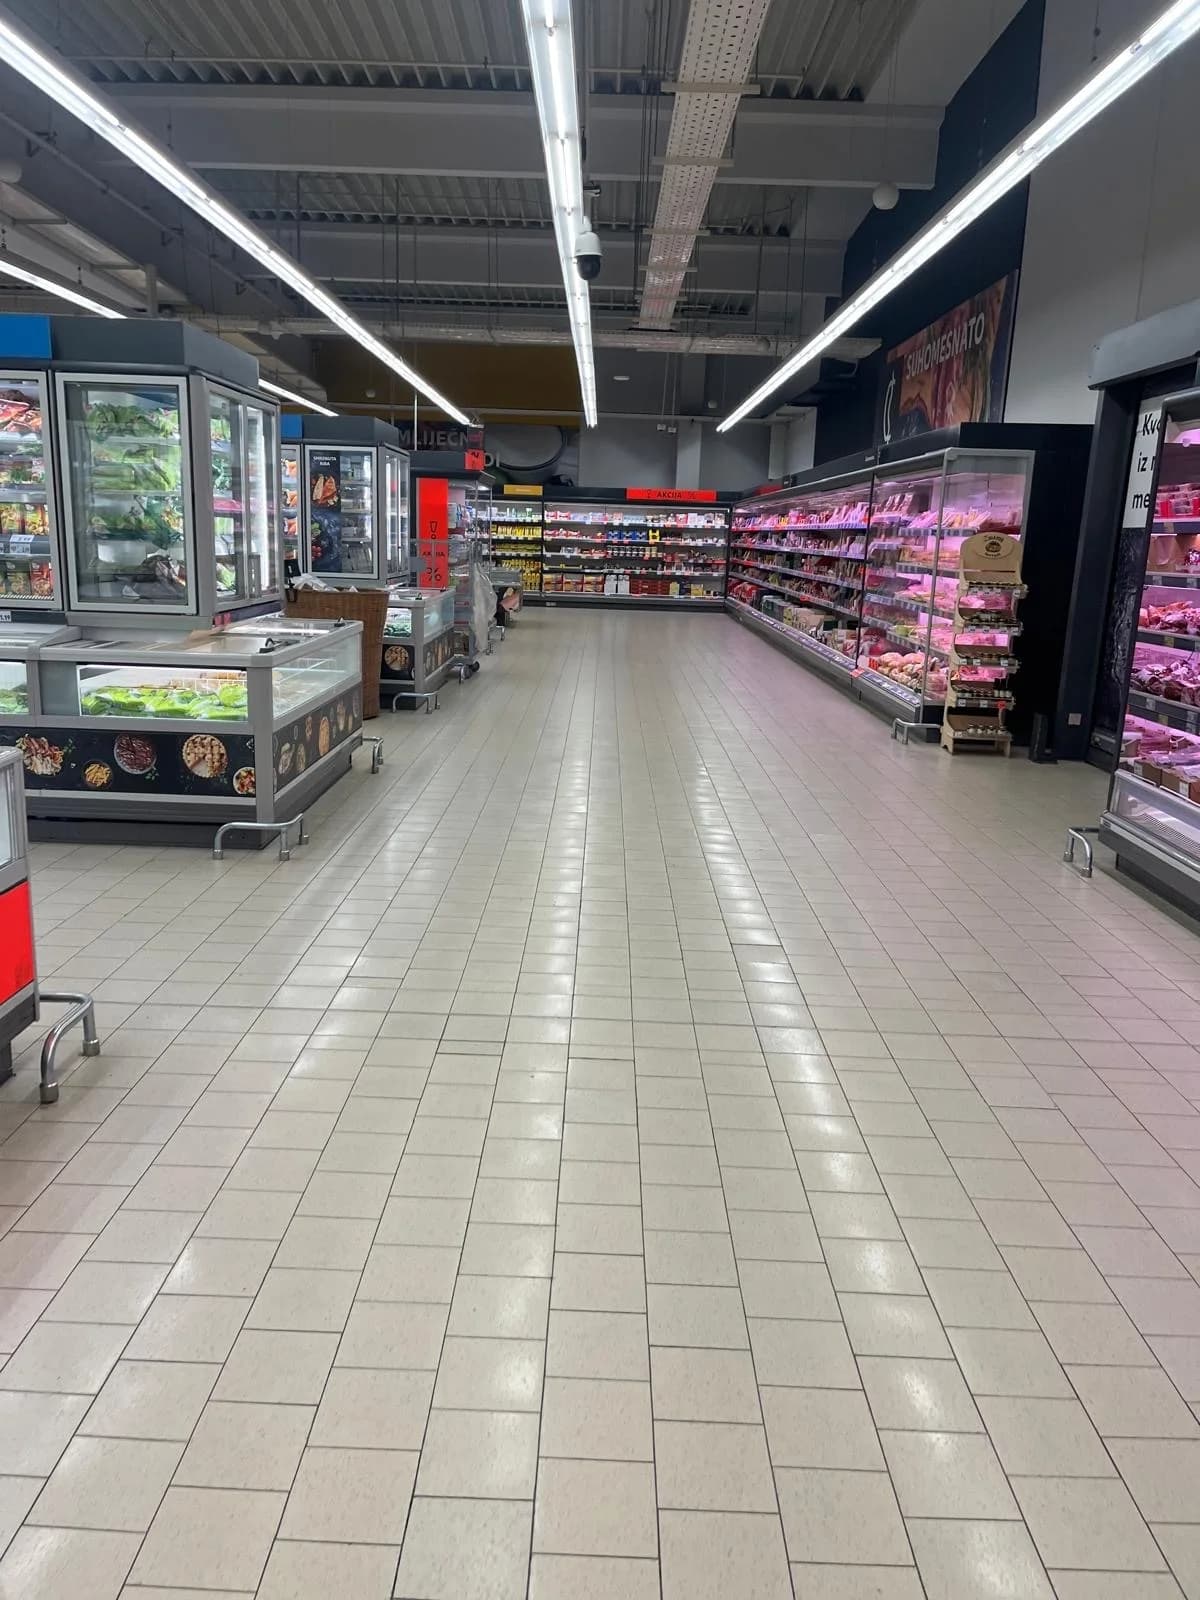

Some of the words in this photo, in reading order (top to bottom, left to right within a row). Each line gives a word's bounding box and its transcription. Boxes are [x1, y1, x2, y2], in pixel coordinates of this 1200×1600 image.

[905, 311, 985, 380] SUHOMESNATO
[1137, 451, 1148, 472] iz
[656, 488, 682, 499] AKCIJA
